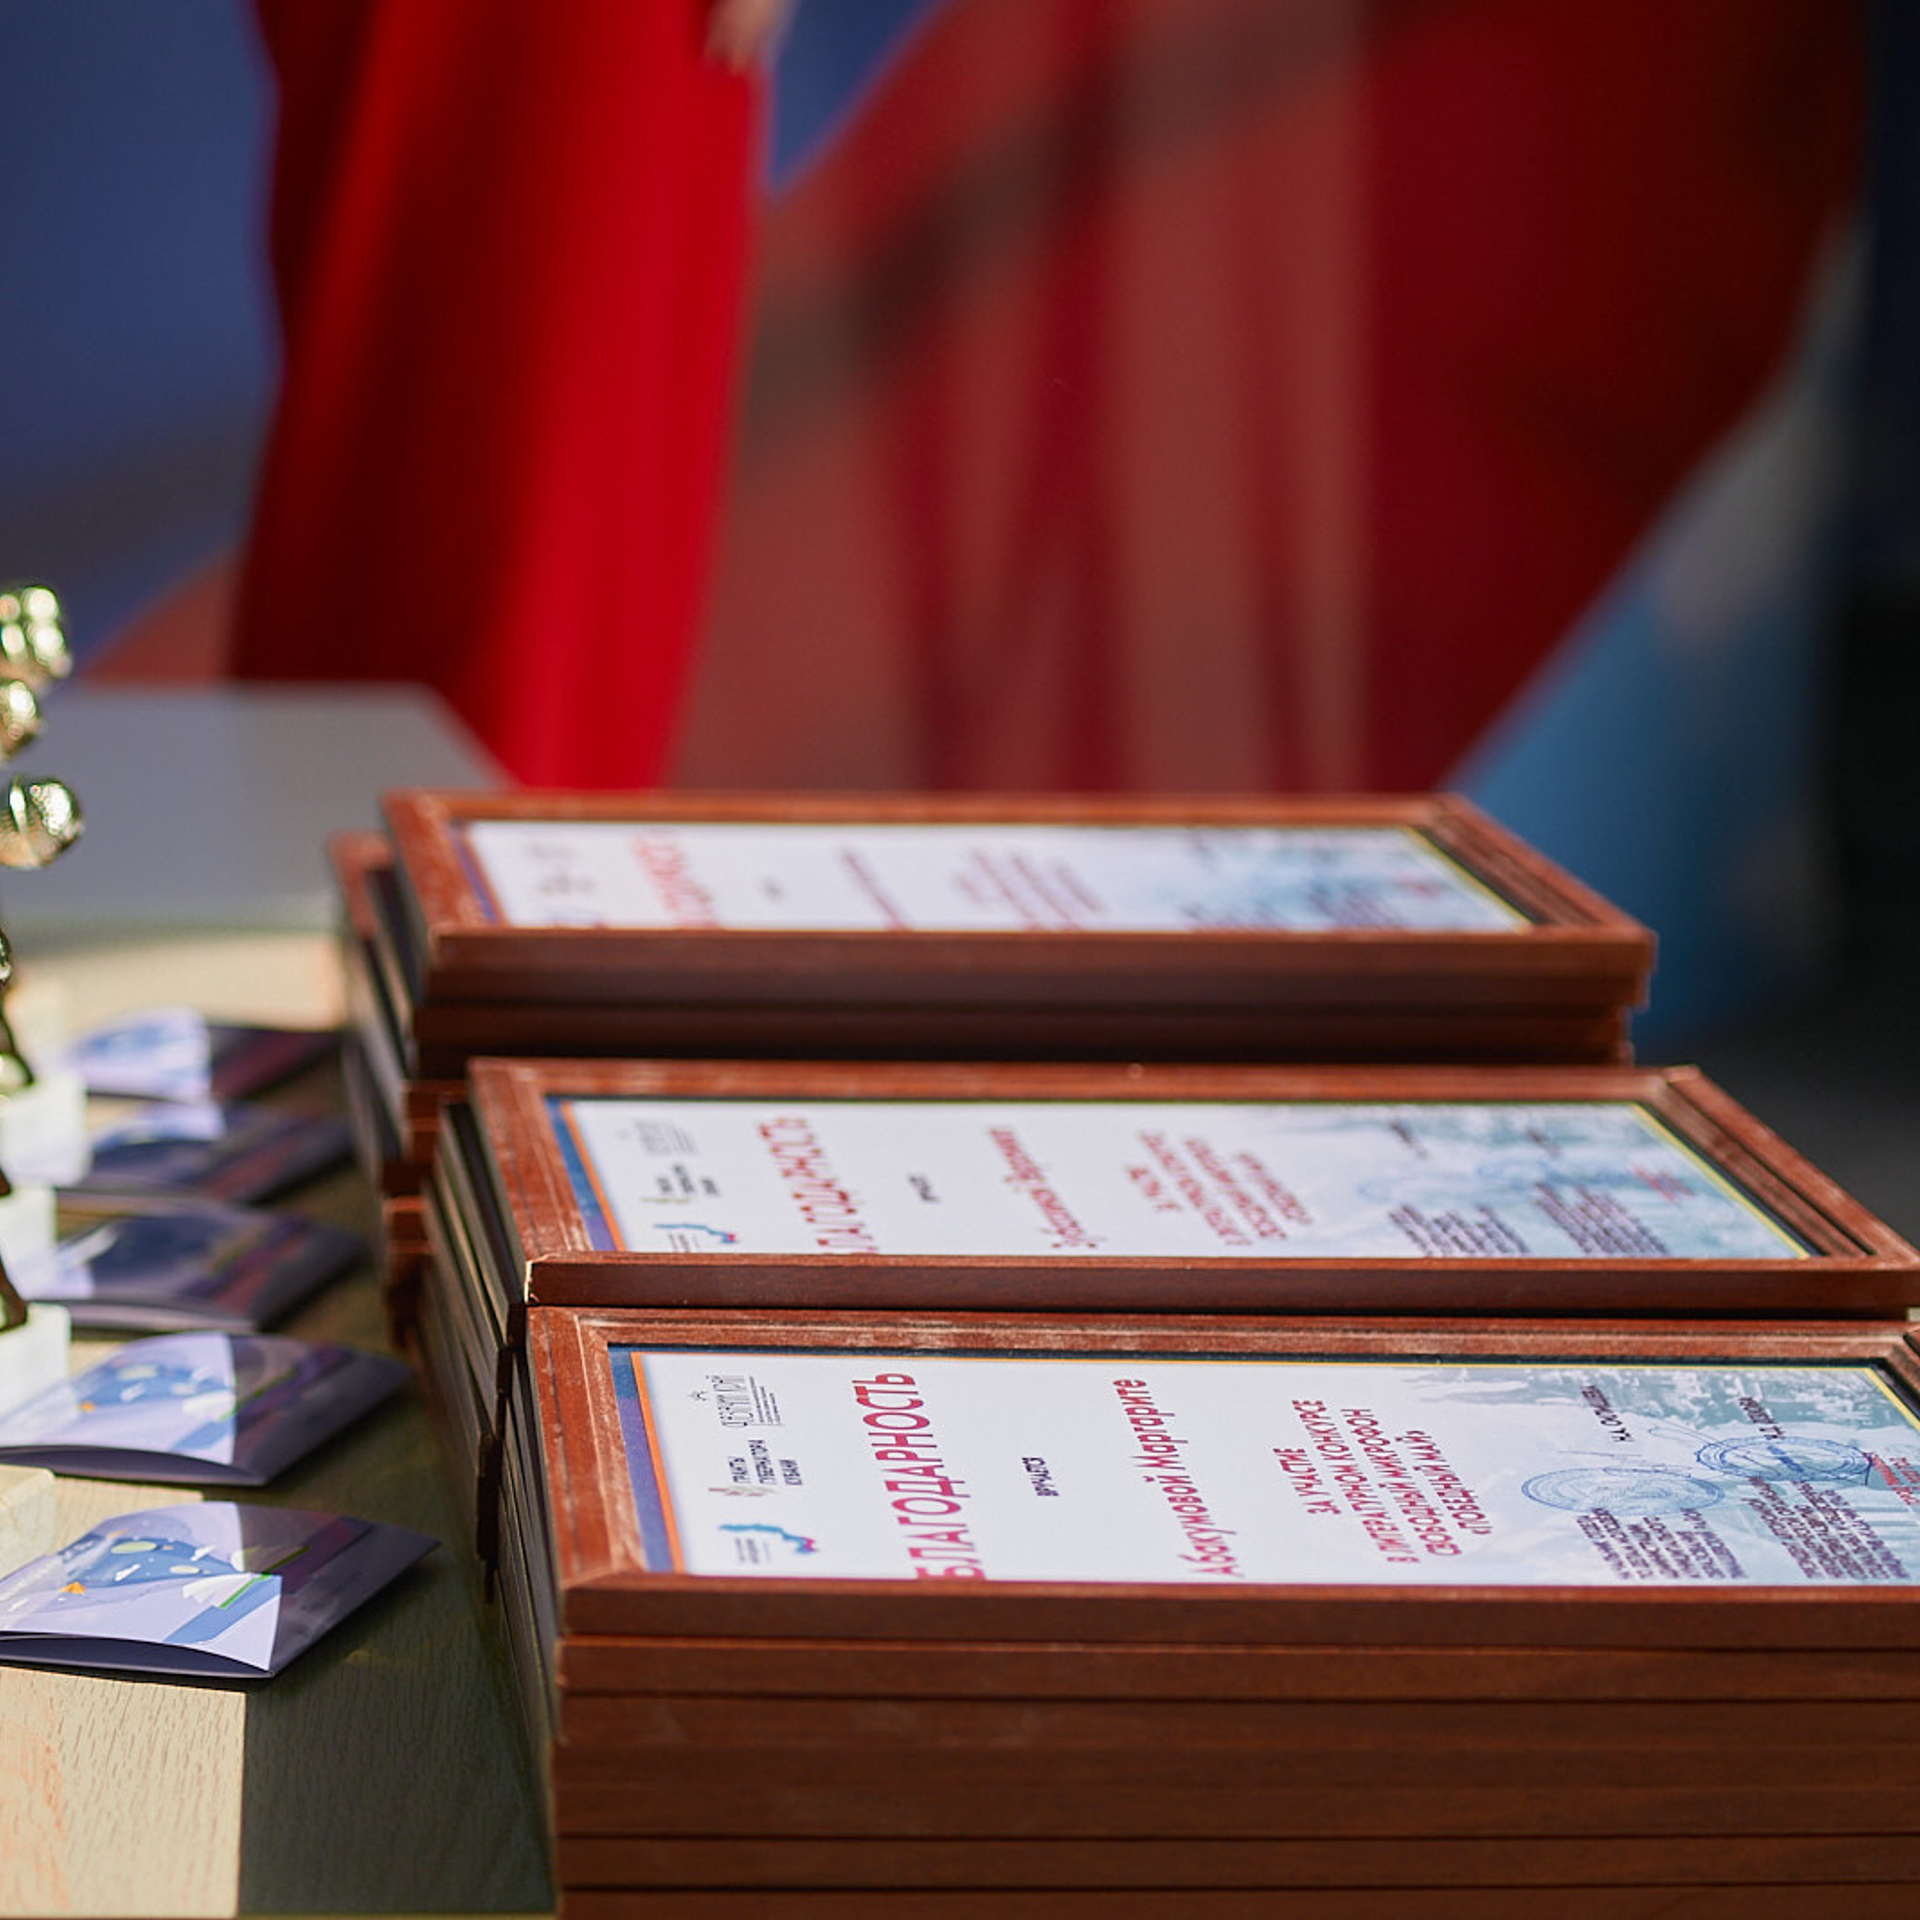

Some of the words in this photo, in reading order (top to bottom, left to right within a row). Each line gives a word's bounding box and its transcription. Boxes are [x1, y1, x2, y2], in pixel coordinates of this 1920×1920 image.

[758, 1117, 880, 1254] ЛАГОДАРНОСТЬ
[1112, 1378, 1189, 1470] Маргарите
[1291, 1399, 1356, 1461] КОНКУРСЕ
[1340, 1408, 1414, 1479] МИКРОФОН
[1394, 1429, 1447, 1462] МАЙ»
[852, 1372, 987, 1580] БЛАГОДАРНОСТЬ
[1272, 1448, 1331, 1497] УЧАСТИЕ
[1303, 1500, 1342, 1515] ЗА
[1412, 1464, 1493, 1535] «ПОБЕДНЫЙ
[1142, 1474, 1245, 1578] Абакумовой
[1326, 1464, 1415, 1555] ЛИТЕРАТУРНОМ
[1377, 1481, 1463, 1557] СВОБОДНЫЙ
